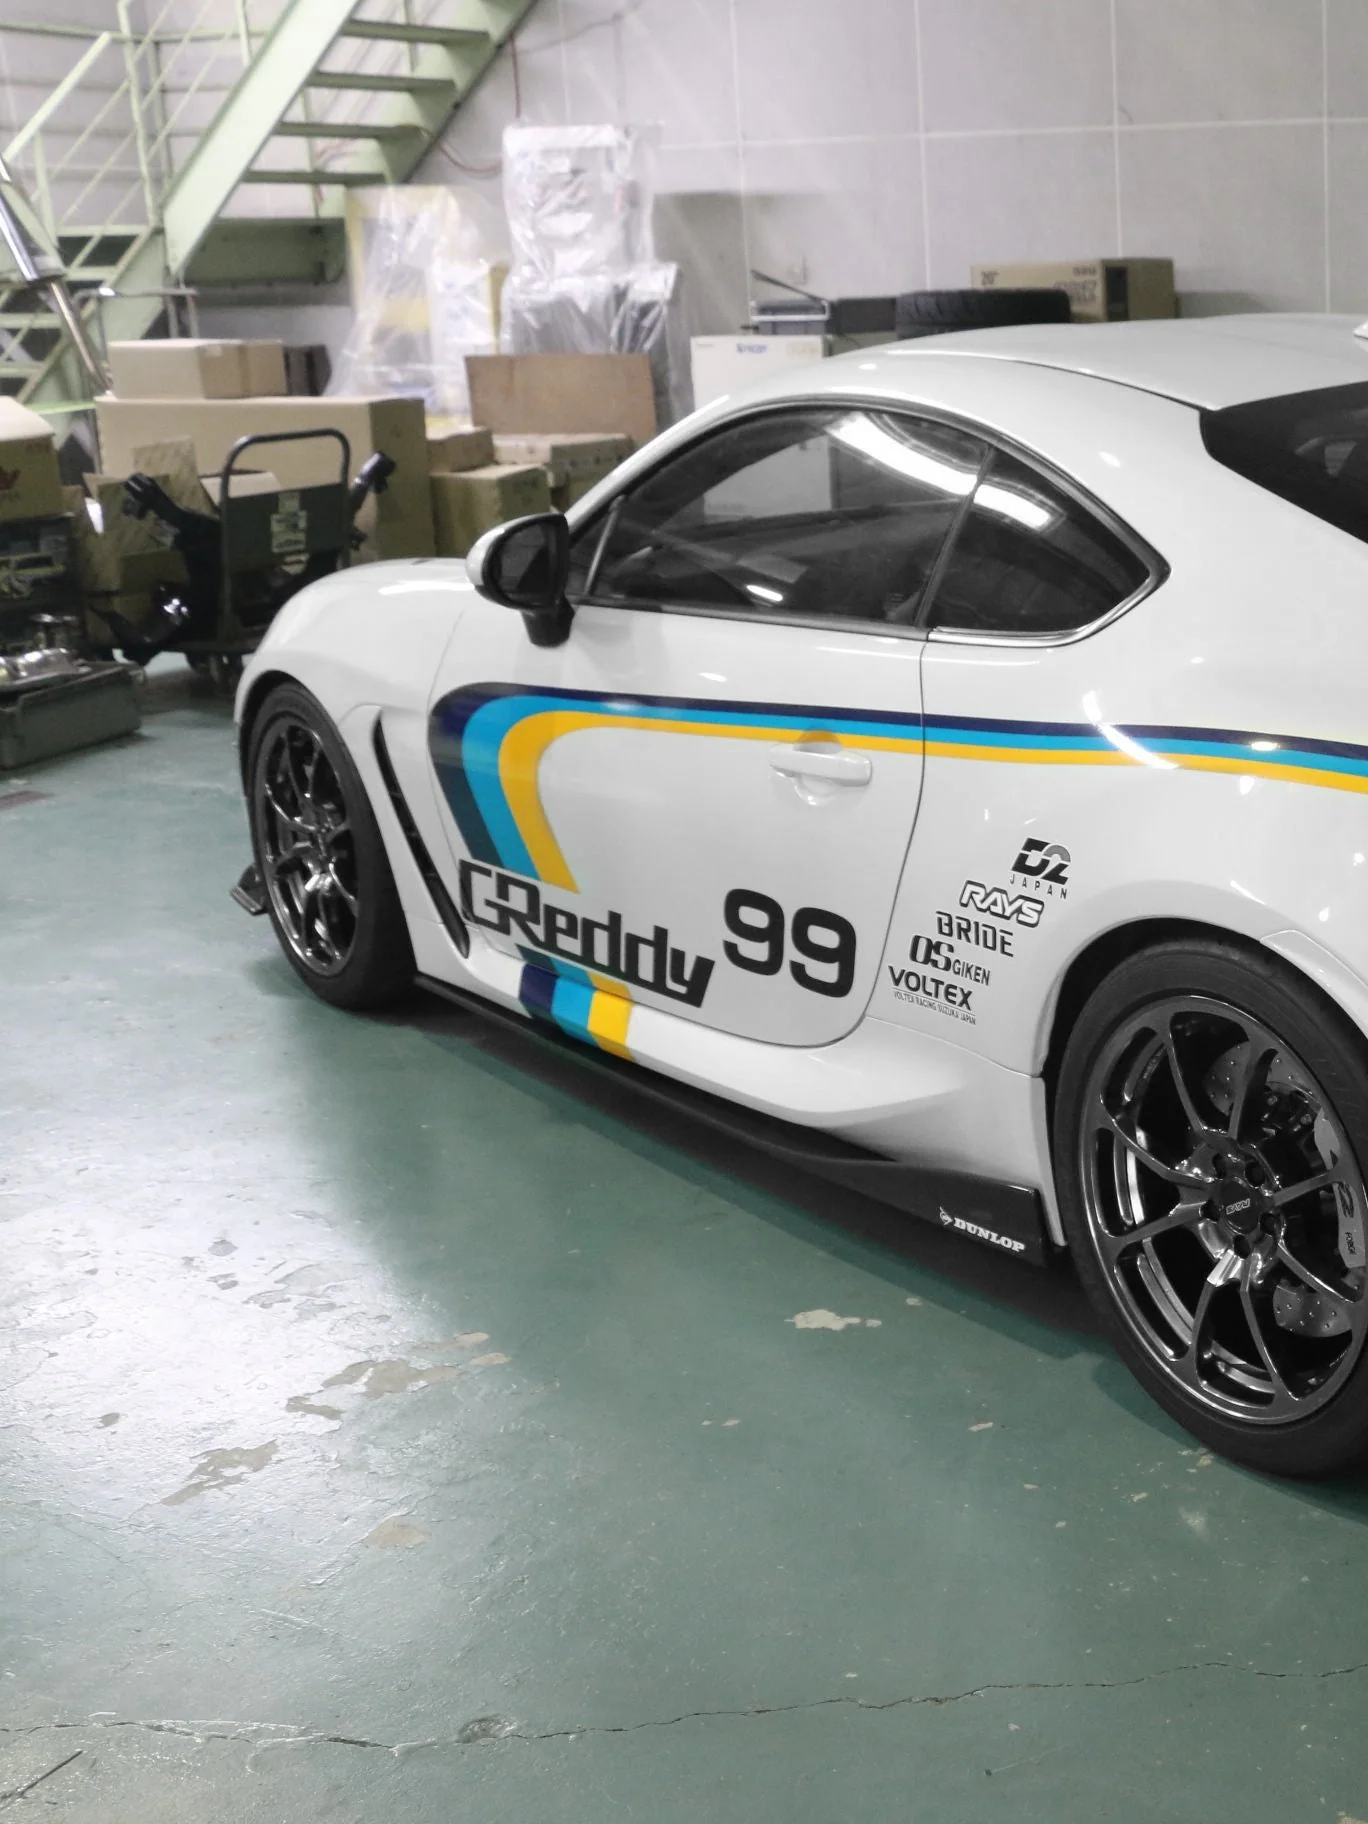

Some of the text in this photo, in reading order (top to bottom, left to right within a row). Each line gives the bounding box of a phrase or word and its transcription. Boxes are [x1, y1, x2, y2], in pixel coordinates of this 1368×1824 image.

[1010, 837, 1071, 886] D2
[960, 880, 1045, 928] RAYS
[1009, 873, 1068, 900] JAPAN
[459, 859, 715, 1008] GReddy
[722, 888, 857, 998] 99
[936, 910, 1014, 958] BRIDE
[909, 934, 991, 986] OS GIKEN
[888, 965, 973, 1011] VOLTEX
[1225, 1198, 1251, 1215] RAYS
[953, 1216, 1026, 1253] DUNLOP
